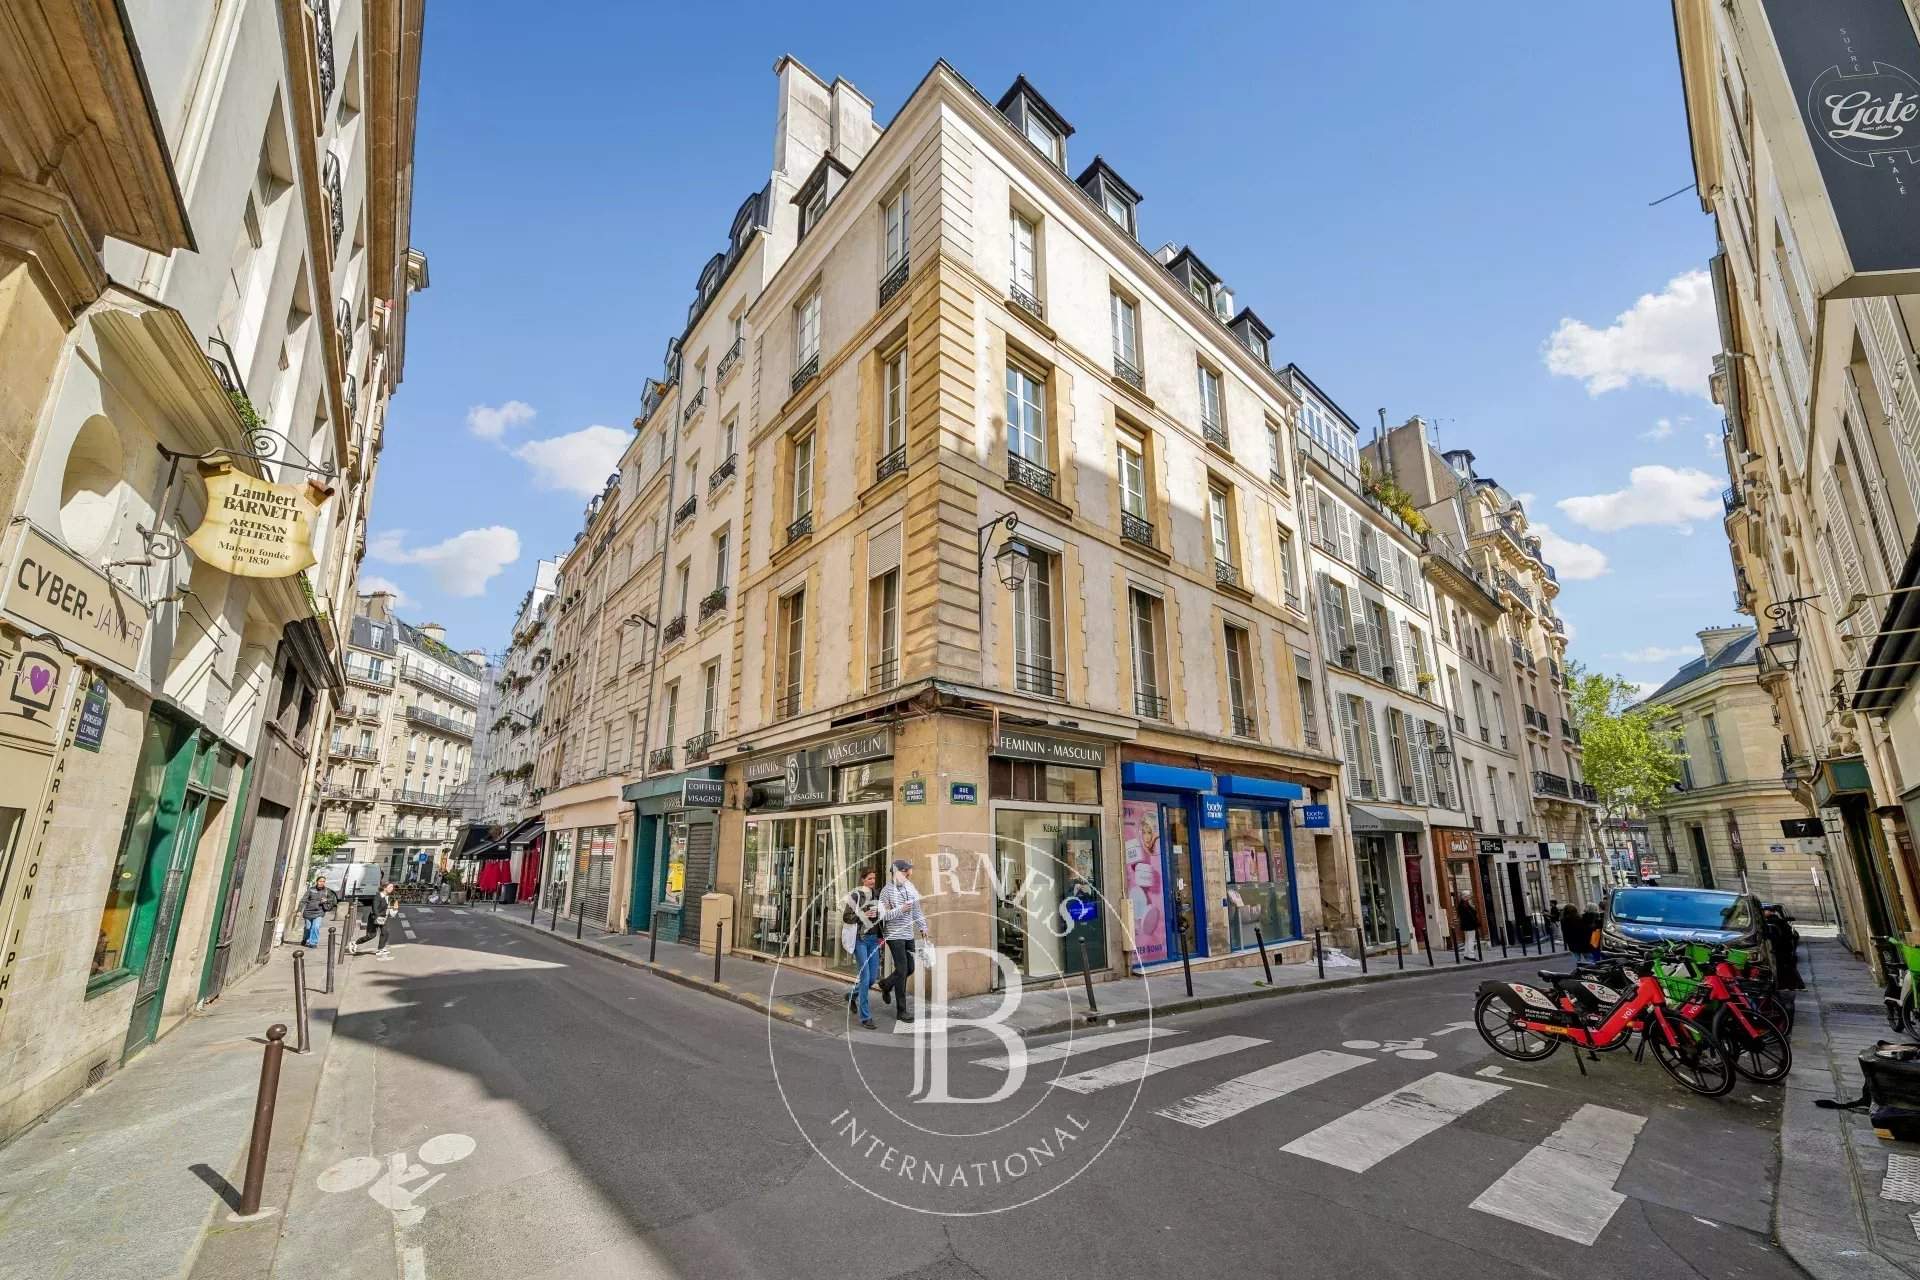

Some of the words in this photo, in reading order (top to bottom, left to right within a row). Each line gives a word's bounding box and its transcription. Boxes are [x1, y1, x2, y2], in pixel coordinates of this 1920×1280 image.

[1825, 91, 1919, 140] Gâté
[232, 483, 298, 508] Lambert
[223, 496, 303, 522] BARNETT
[229, 518, 288, 535] ARTISAN
[229, 526, 285, 544] RELIEUR
[218, 540, 256, 555] Maison
[258, 548, 291, 561] fondée
[232, 554, 244, 562] en
[248, 555, 270, 566] 1830
[827, 735, 882, 761] MASCULIN
[1000, 736, 1045, 753] FEMININ
[1053, 744, 1102, 761] MASCULIN
[688, 783, 722, 792] COIFFEUR
[688, 795, 722, 803] VISAGISTE
[1206, 801, 1222, 812] body
